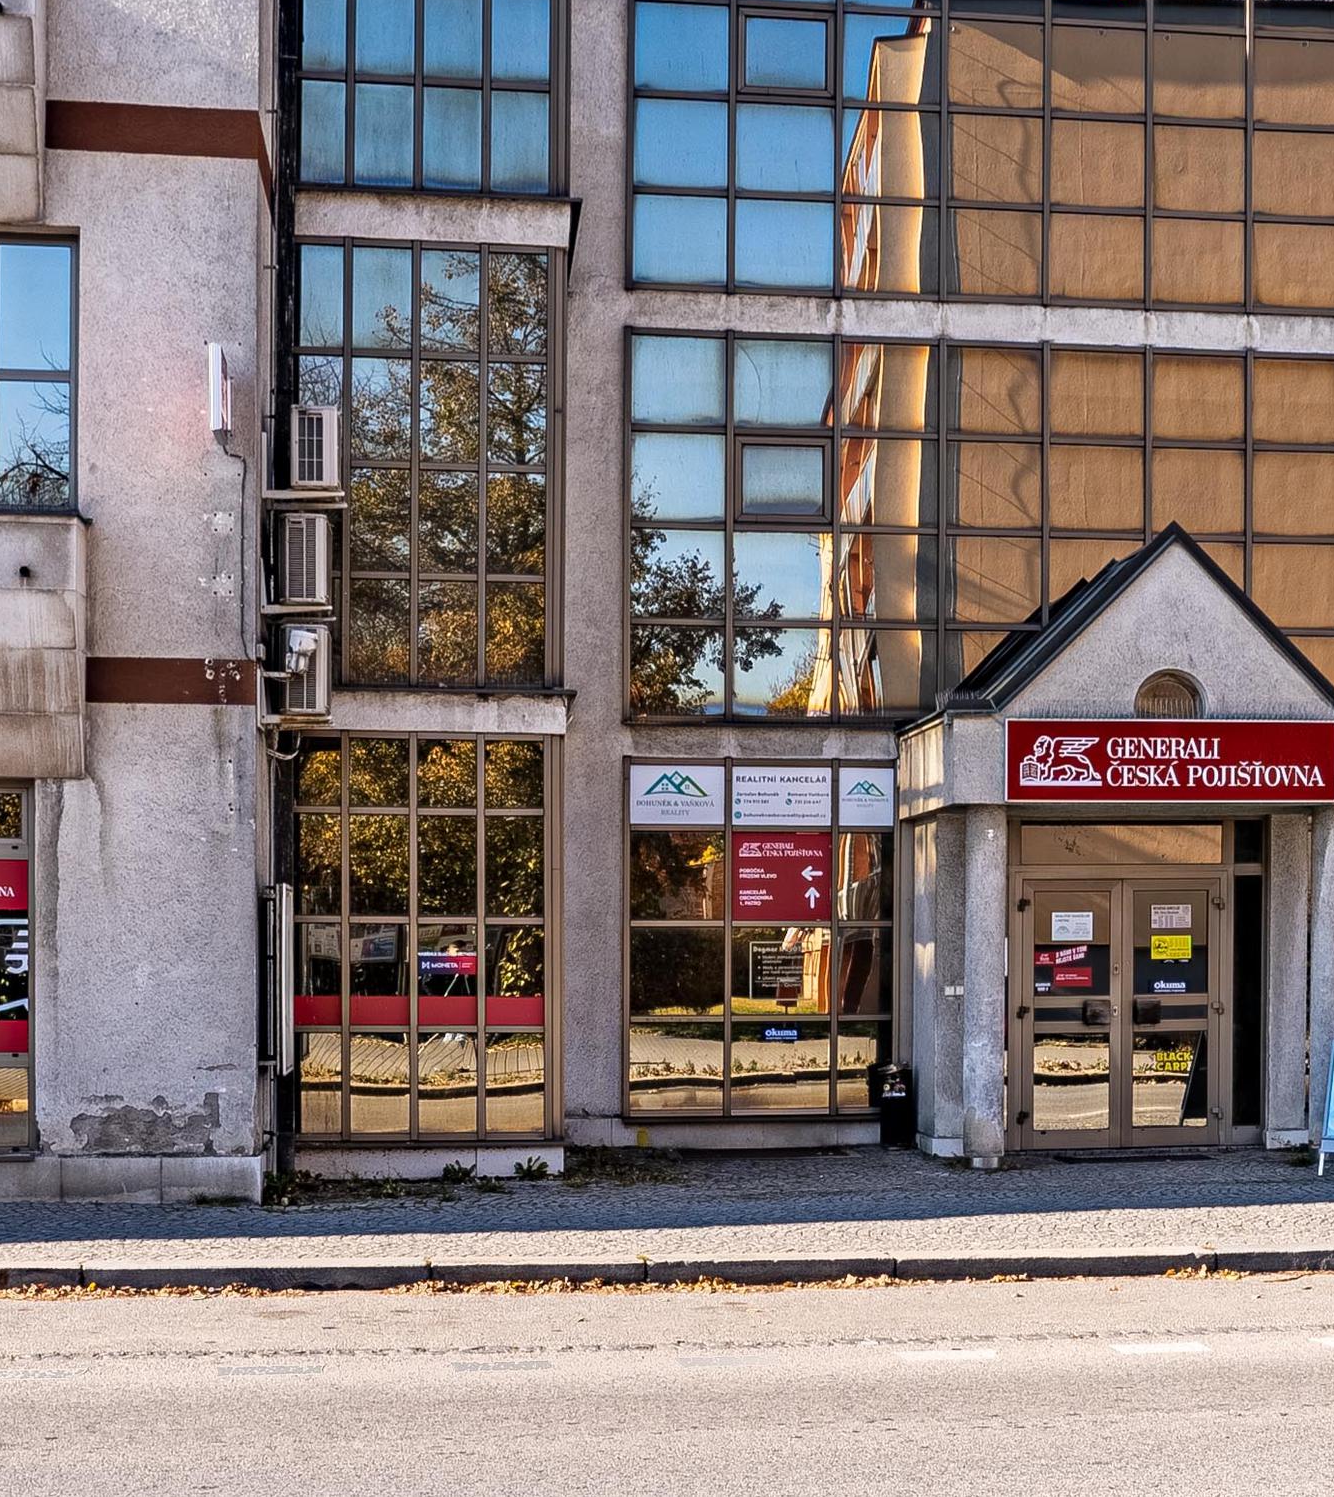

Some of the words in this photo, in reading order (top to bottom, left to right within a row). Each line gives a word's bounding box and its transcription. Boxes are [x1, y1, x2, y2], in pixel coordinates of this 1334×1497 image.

[1107, 738, 1220, 760] GENERALI
[1107, 761, 1180, 787] ČESKÁ
[1187, 760, 1325, 787] POJIŠŤOVNA
[736, 775, 776, 783] REALITNÍ
[780, 775, 827, 783] KANCELÁŘ
[1154, 980, 1186, 989] okuma
[765, 1028, 797, 1036] okuma
[1157, 1052, 1191, 1061] BLACK
[1157, 1062, 1187, 1071] CARP
